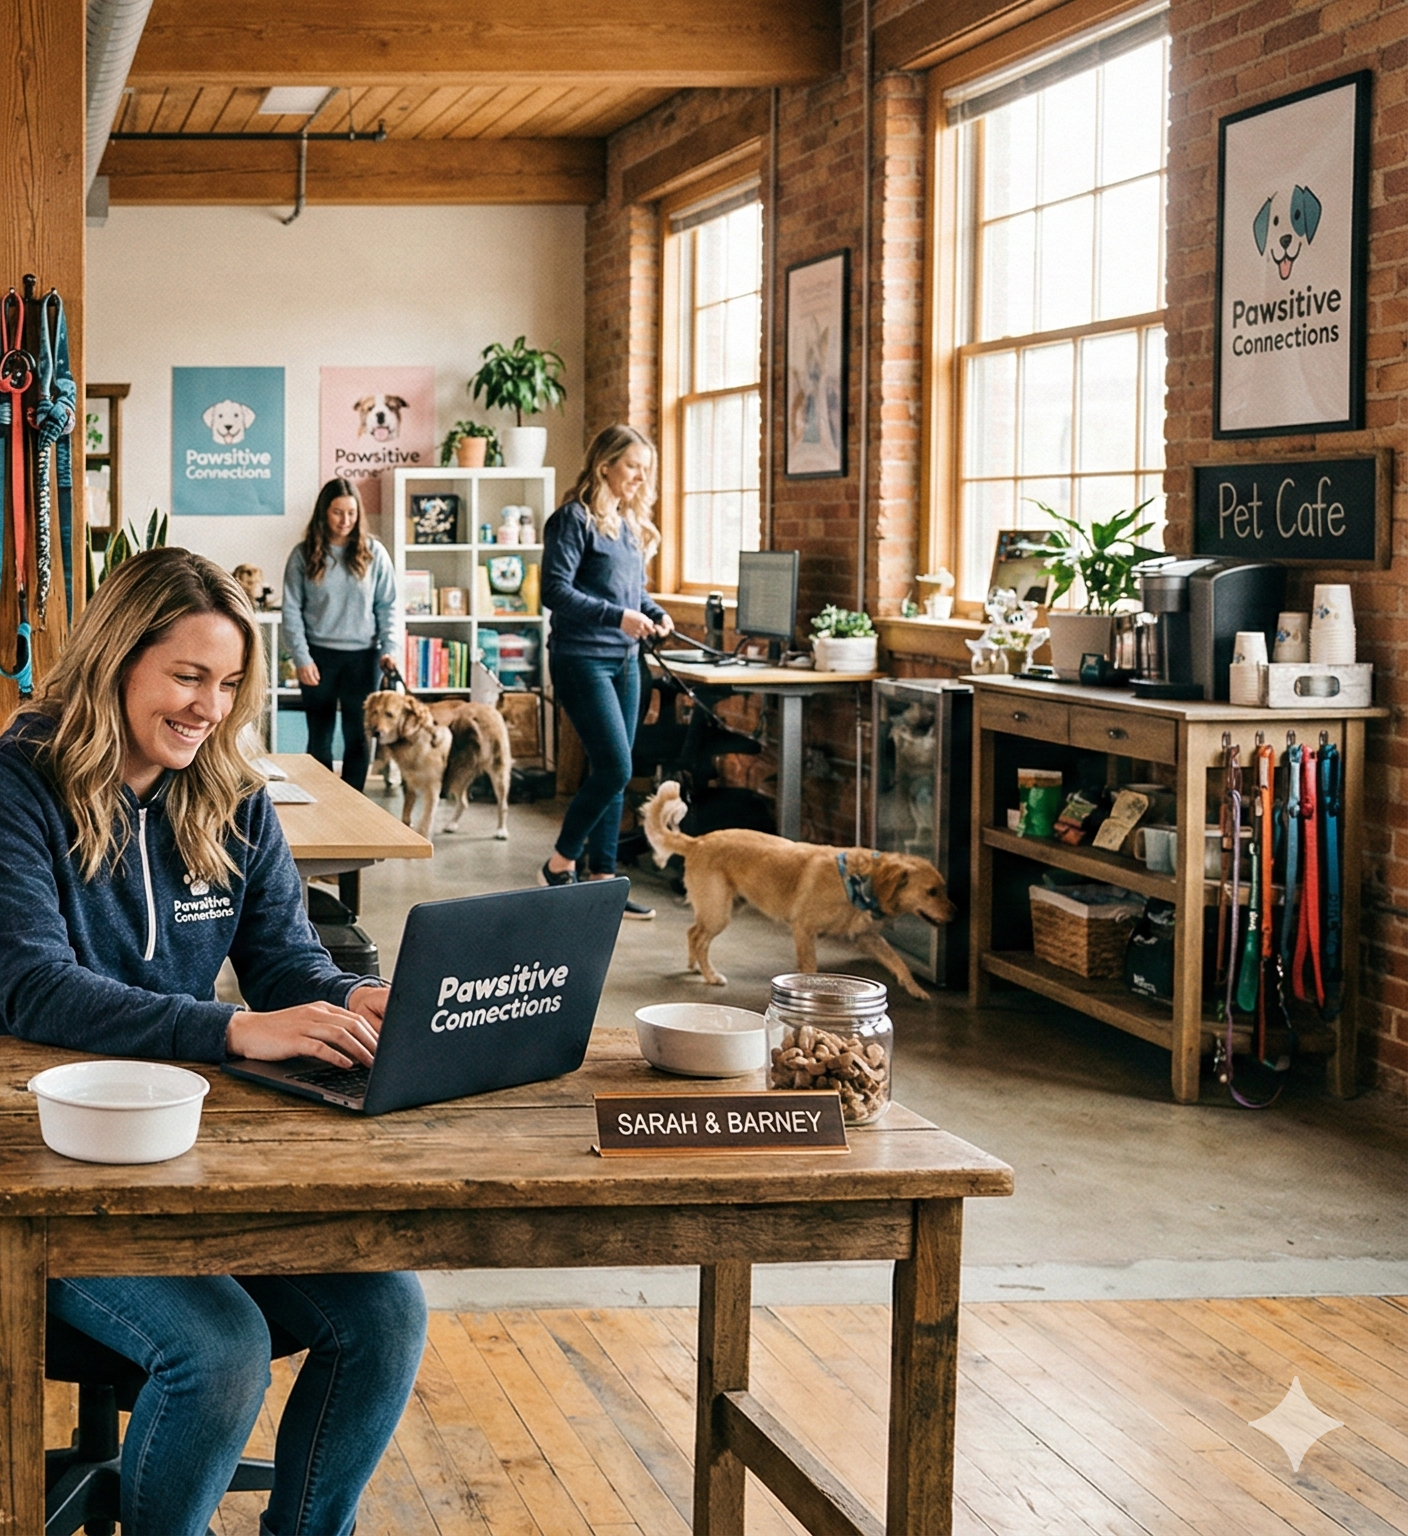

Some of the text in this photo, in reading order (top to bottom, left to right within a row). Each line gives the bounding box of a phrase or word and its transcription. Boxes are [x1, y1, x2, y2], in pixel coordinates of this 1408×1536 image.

[1232, 285, 1342, 329] Pawsitive
[1232, 320, 1340, 357] Connections
[185, 465, 271, 480] Connections
[186, 448, 271, 466] Pawsitive
[335, 447, 421, 463] Pawsitive
[1218, 475, 1347, 540] Pet Cafe
[436, 960, 570, 1007] Pawsitive
[430, 991, 562, 1034] Connections
[617, 1110, 822, 1136] SARAH & BARNEY
